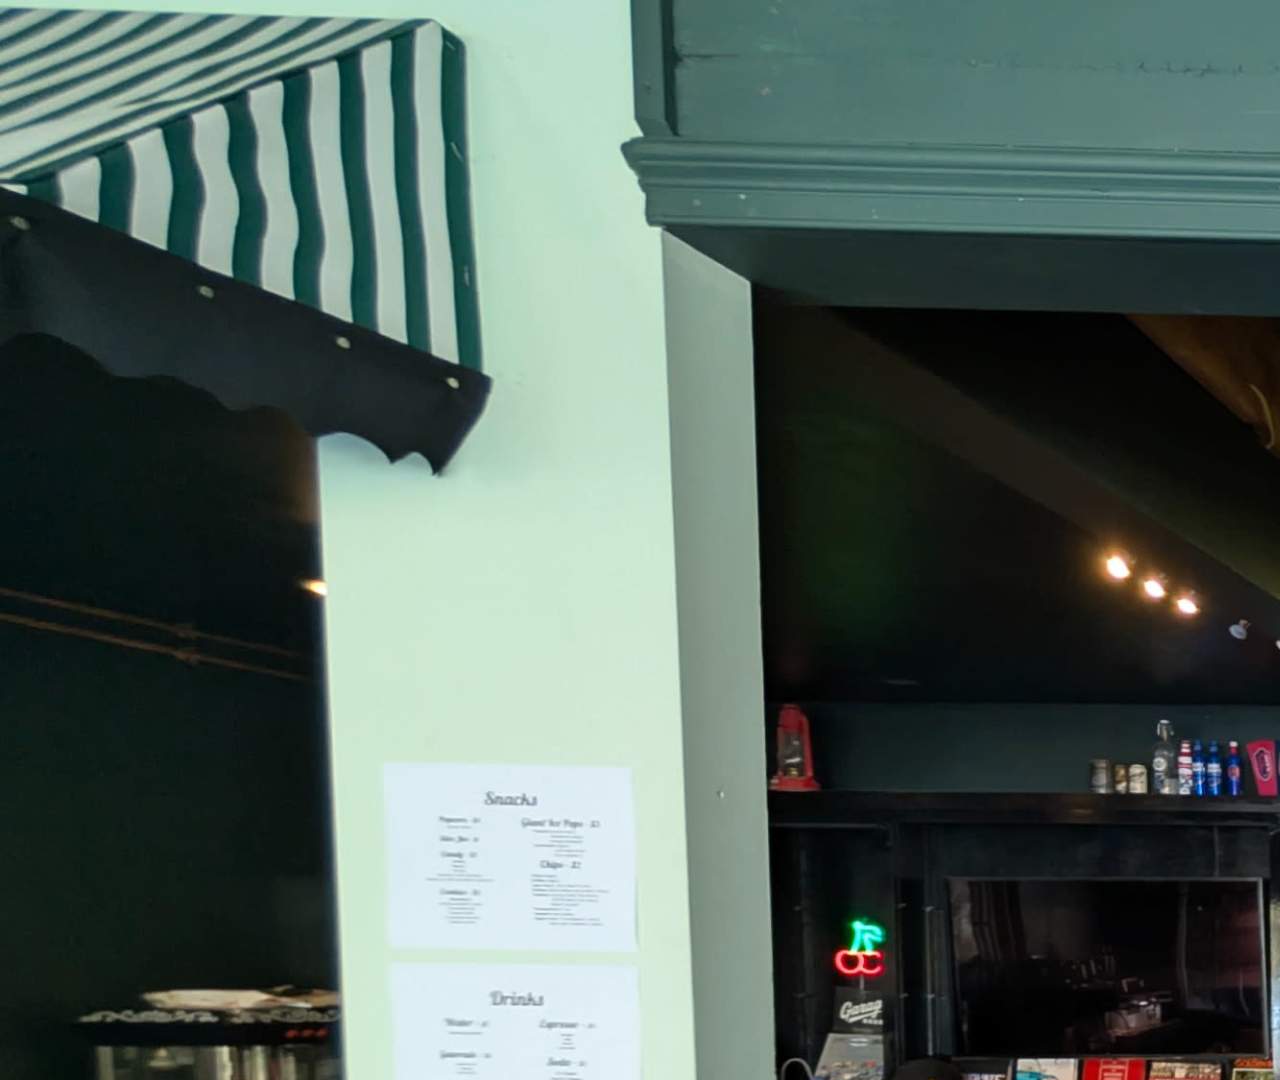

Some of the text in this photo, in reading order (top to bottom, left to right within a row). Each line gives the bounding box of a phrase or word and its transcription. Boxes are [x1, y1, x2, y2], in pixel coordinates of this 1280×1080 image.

[484, 791, 538, 807] Snacks
[490, 990, 545, 1006] Drinks
[839, 1000, 883, 1023] Garag
